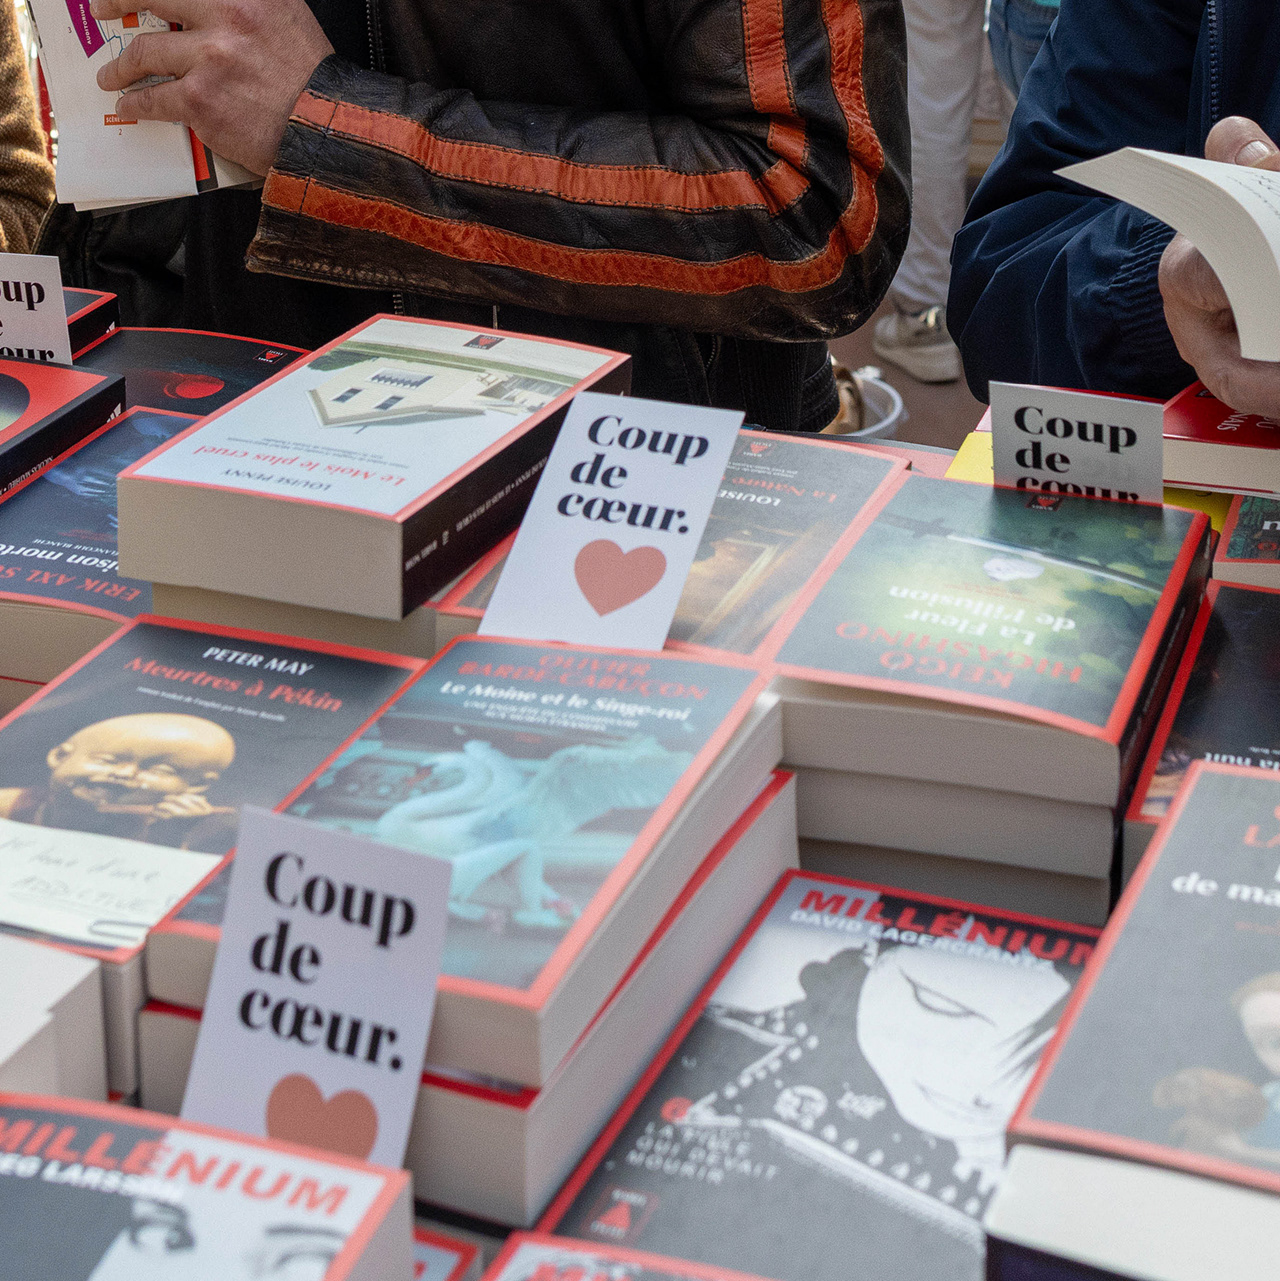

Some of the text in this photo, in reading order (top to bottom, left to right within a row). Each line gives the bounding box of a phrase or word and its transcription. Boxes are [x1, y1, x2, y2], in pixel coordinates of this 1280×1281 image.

[78, 3, 92, 45] AUDITORIUM
[587, 414, 711, 465] Coup
[1014, 405, 1138, 456] Coup
[30, 455, 55, 478] NICOLAS
[193, 443, 249, 460] cruel
[252, 451, 297, 473] plus
[297, 461, 324, 475] le
[1015, 440, 1072, 474] de
[220, 468, 333, 493] LOUISE PENNY
[325, 464, 366, 484] Mois
[372, 471, 408, 488] Le
[570, 453, 628, 489] de
[742, 478, 811, 499] Nature
[557, 491, 690, 535] cœur.
[32, 539, 73, 550] BLANCHE
[25, 568, 76, 587] AXL
[77, 577, 143, 602] ERIK
[890, 585, 1077, 633] de l'illusion
[905, 607, 1038, 646] La Fleur
[202, 646, 315, 678] PETER MAY
[539, 654, 652, 678] OLIVIER
[835, 621, 1085, 684] HIGASHINO
[879, 651, 1016, 689] KEIGO
[123, 654, 243, 695] Meurtres
[247, 677, 266, 697] à
[272, 681, 344, 714] Pékin
[457, 660, 709, 701] BARDE-CABUÇON
[440, 680, 467, 698] Le
[469, 682, 538, 707] Moine
[540, 687, 563, 705] et
[567, 689, 592, 708] le
[594, 694, 691, 724] Singe-roi
[264, 849, 418, 950] Coup
[1171, 867, 1221, 897] de
[790, 910, 868, 937] DAVID
[251, 919, 322, 985] de
[237, 985, 405, 1072] cœur.
[41, 1163, 187, 1205] LARSSON
